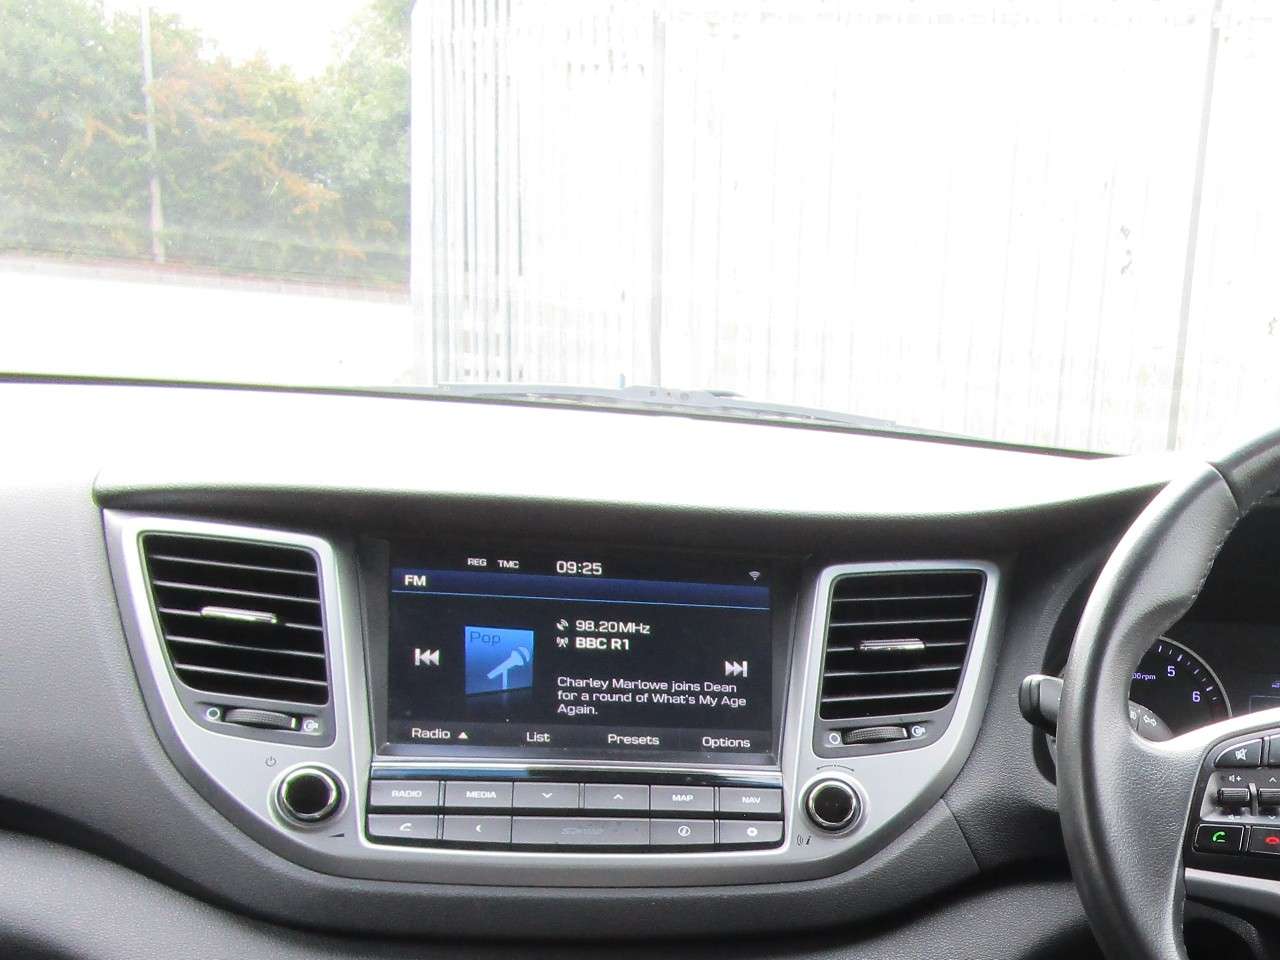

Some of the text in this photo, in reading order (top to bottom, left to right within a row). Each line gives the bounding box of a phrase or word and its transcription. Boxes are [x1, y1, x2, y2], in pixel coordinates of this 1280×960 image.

[467, 558, 487, 567] REG
[497, 559, 519, 569] TMC
[556, 560, 603, 575] 09:25
[404, 575, 426, 587] FM
[469, 631, 500, 646] Pop
[575, 637, 630, 651] BBC R1
[1167, 665, 1176, 677] 5
[557, 676, 737, 693] Charley Marlowe joins Dean
[557, 689, 747, 708] for a round of What's My Age
[1192, 690, 1201, 703] 6
[557, 703, 598, 716] Again.
[411, 727, 451, 740] Radio
[526, 731, 551, 743] List
[607, 733, 660, 746] Presets
[702, 735, 751, 749] Options
[391, 789, 422, 798] RADIO
[466, 790, 497, 799] MEDIA
[671, 794, 694, 802] MAP
[742, 796, 761, 804] NAV
